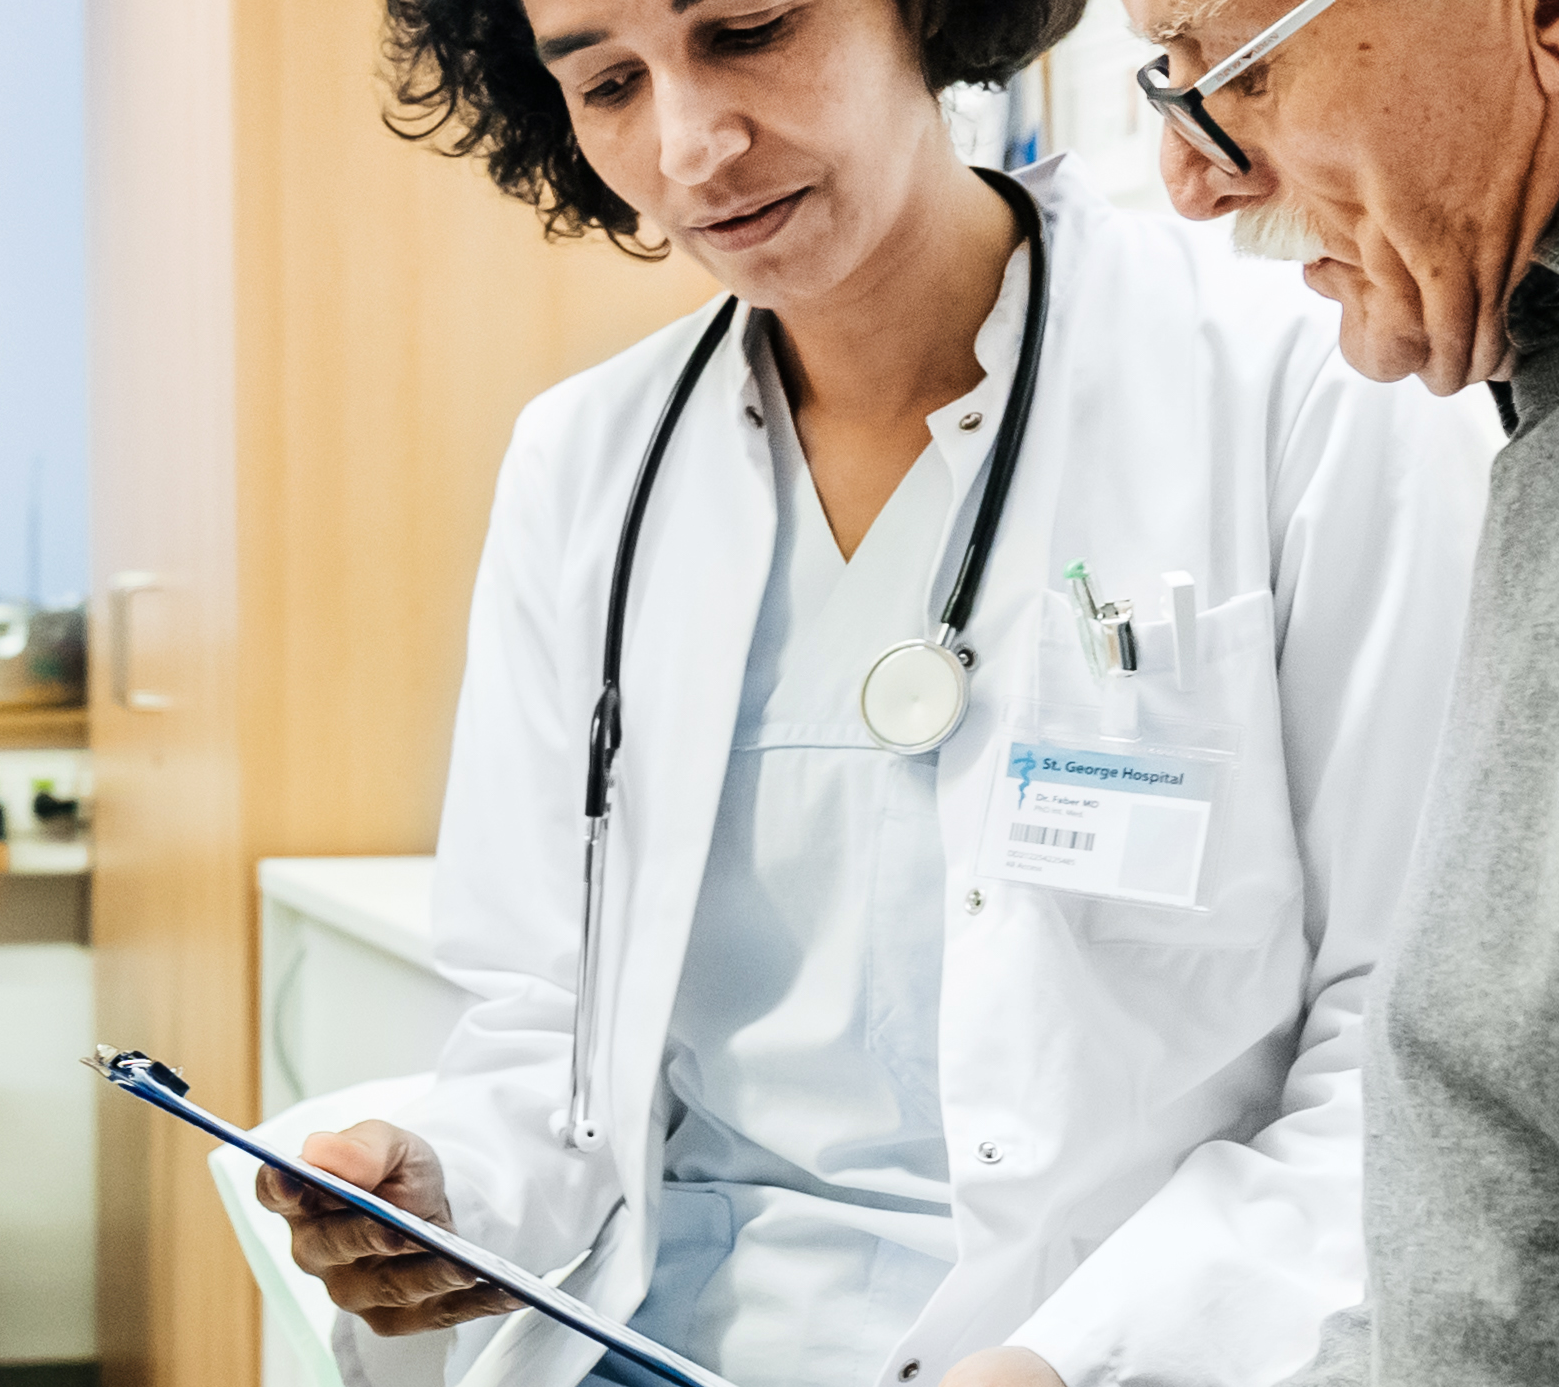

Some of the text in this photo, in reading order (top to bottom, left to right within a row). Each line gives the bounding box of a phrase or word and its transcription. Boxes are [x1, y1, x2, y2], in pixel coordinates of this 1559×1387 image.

[1042, 757, 1185, 785] St. George Hospital
